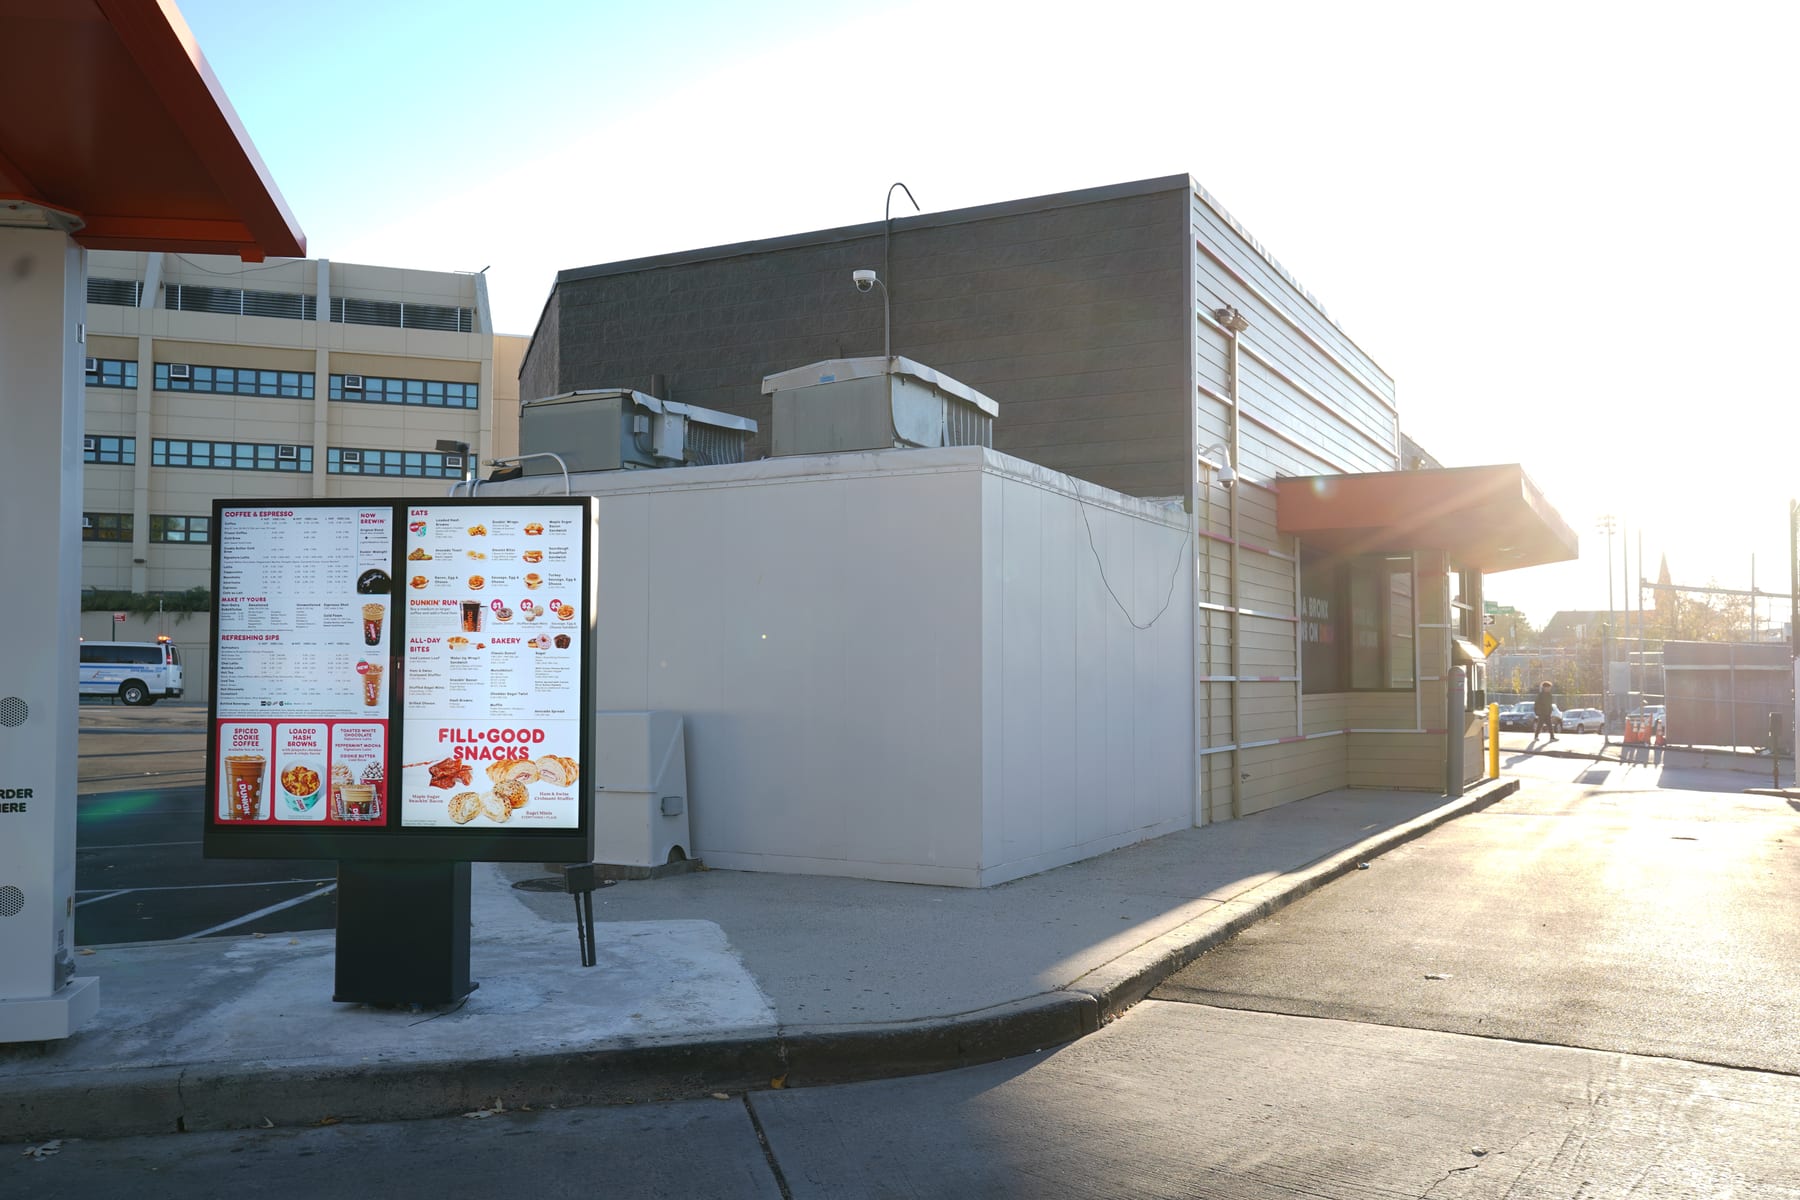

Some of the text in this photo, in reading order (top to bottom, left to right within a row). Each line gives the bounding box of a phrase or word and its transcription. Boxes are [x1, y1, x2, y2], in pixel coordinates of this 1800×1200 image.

[1308, 597, 1328, 619] BRONX
[453, 746, 529, 761] SNACKS
[0, 802, 27, 813] ERE
